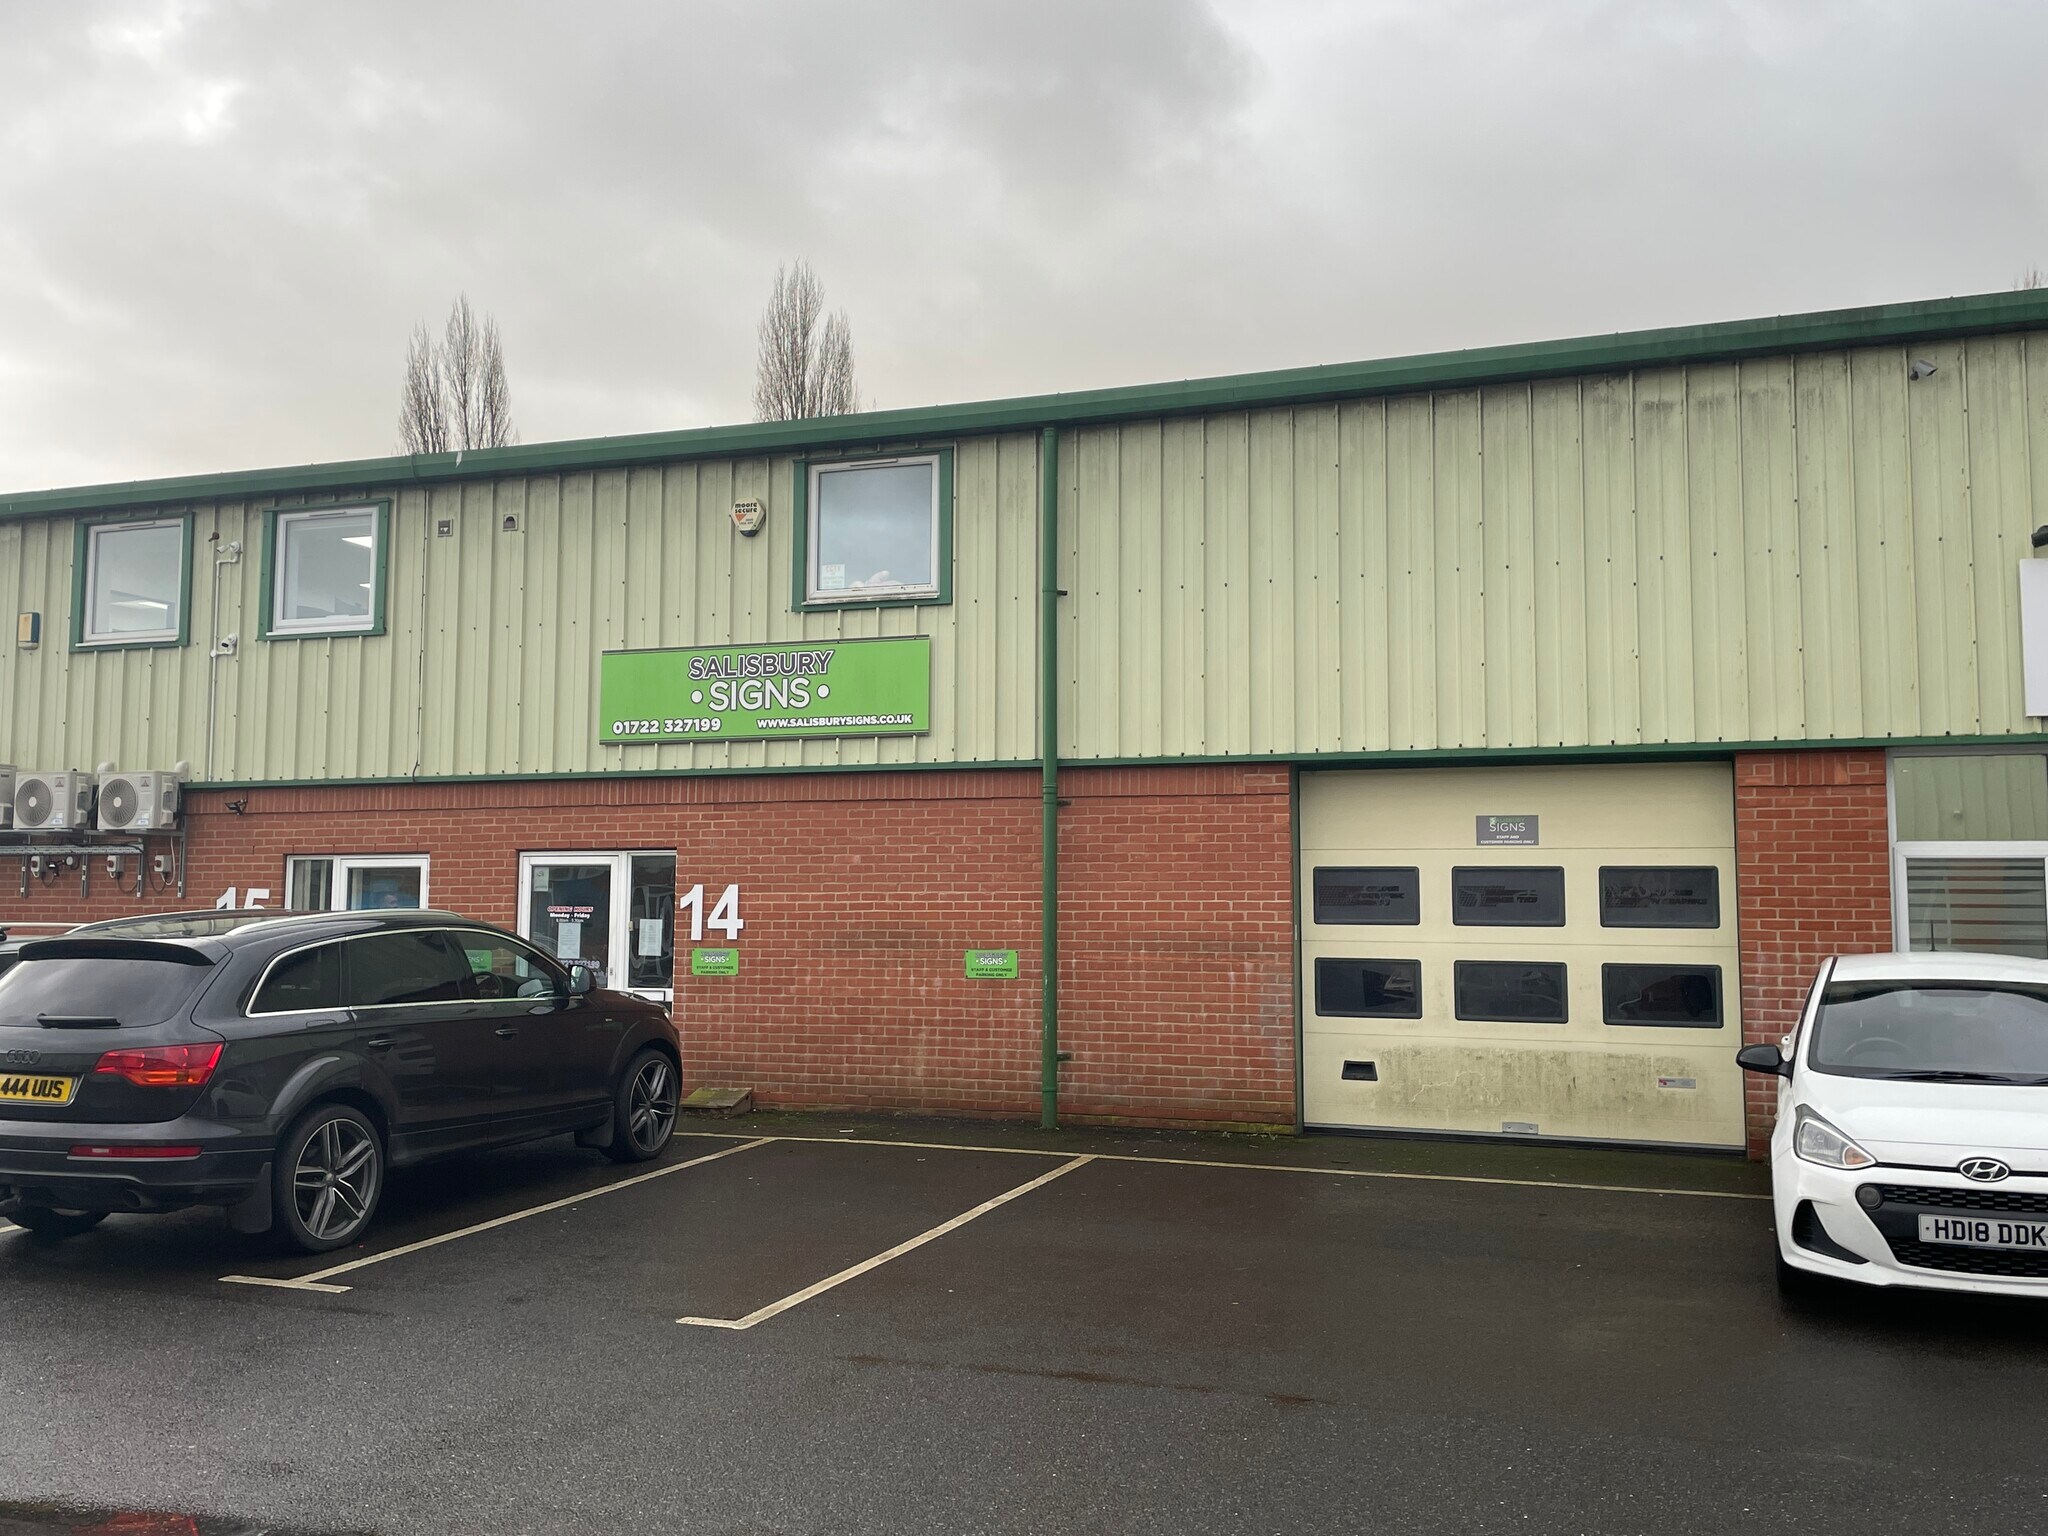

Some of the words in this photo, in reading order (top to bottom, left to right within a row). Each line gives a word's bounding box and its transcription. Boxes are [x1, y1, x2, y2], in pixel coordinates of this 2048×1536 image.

[688, 650, 835, 680] SALISBURY
[708, 678, 811, 711] SIGNS
[612, 719, 660, 735] 01722
[663, 717, 721, 734] 327199
[757, 714, 912, 729] WWW.SALISBURYSIGNS.CO.UK
[1489, 823, 1526, 832] SIGNS
[680, 884, 744, 941] 14
[980, 957, 1003, 965] SIGNS
[1, 1078, 29, 1095] 444
[31, 1079, 64, 1098] UUS
[1998, 1223, 2046, 1246] DDK
